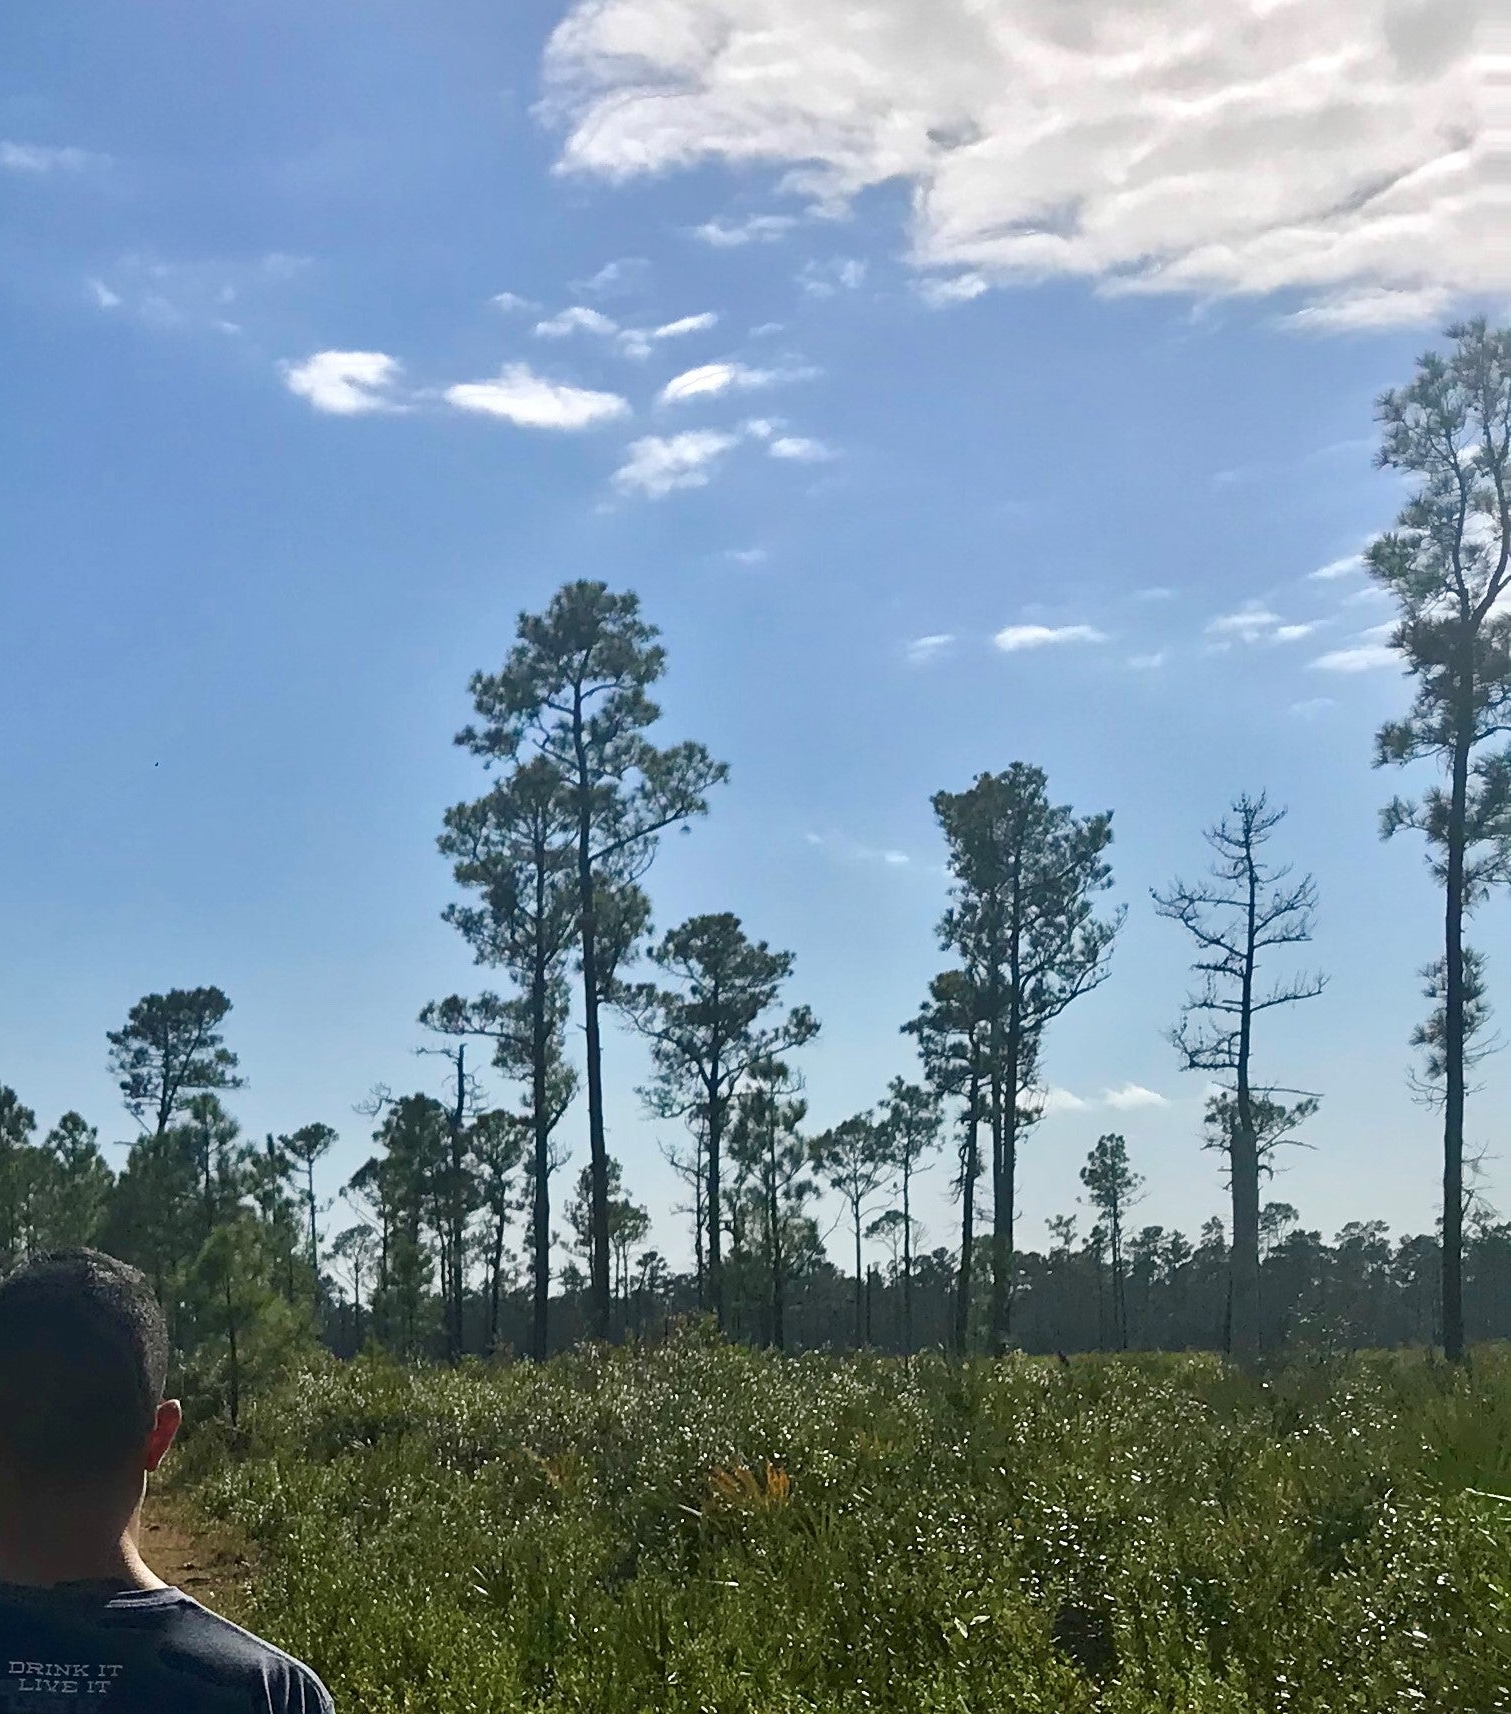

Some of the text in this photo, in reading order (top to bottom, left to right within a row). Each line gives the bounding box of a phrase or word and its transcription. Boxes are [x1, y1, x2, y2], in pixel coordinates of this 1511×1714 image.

[8, 1661, 123, 1677] DRINK IT
[18, 1678, 111, 1693] LIVE IT
